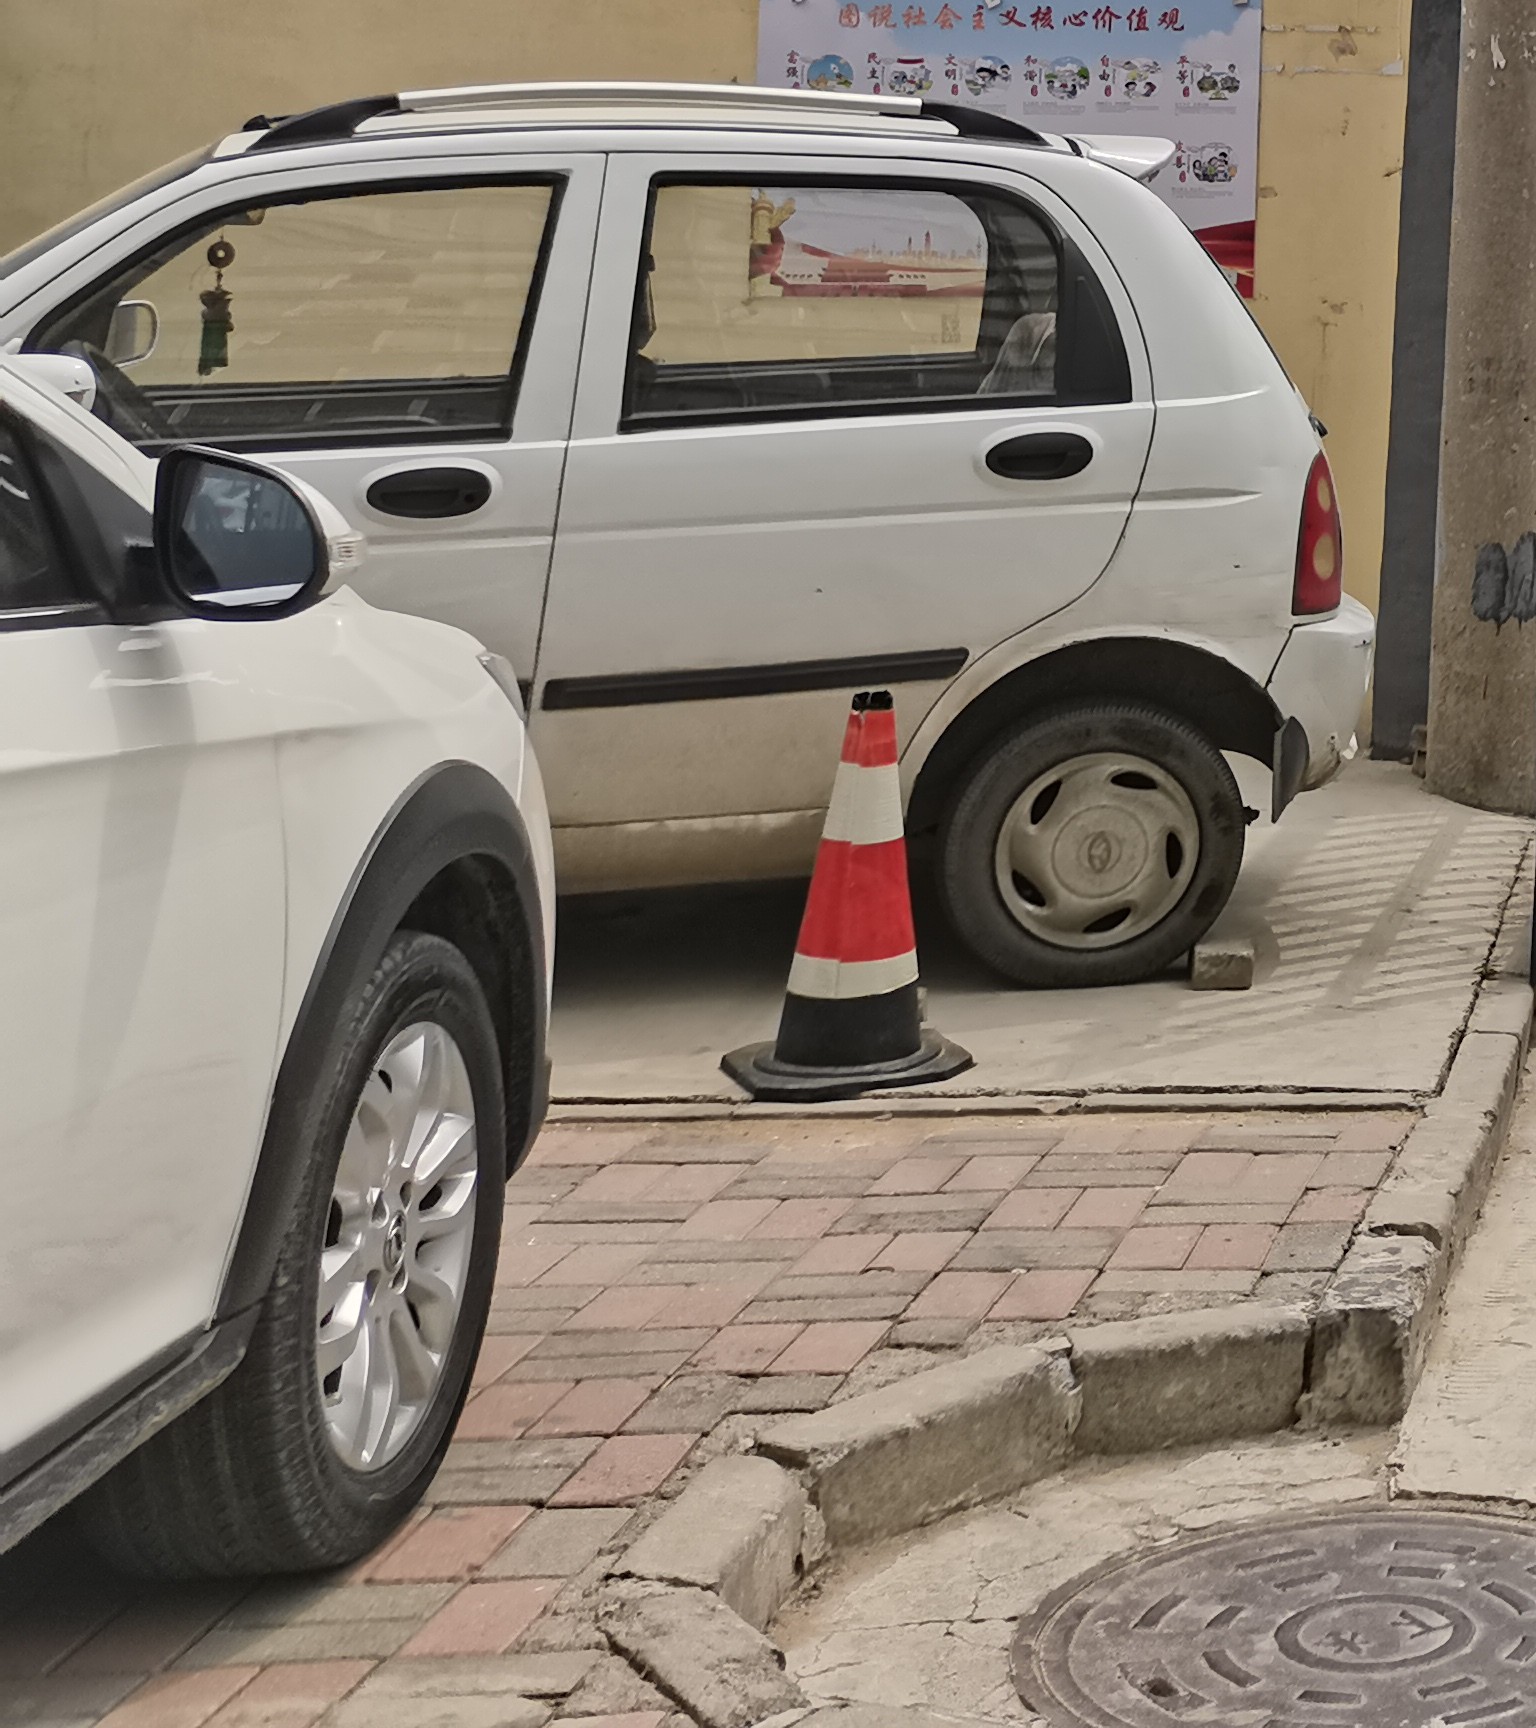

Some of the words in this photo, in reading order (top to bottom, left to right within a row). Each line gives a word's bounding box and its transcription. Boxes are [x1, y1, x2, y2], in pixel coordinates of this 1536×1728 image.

[838, 3, 1185, 33] 图说社会主义核心价值观
[867, 52, 881, 79] 民主
[944, 53, 958, 80] 文明
